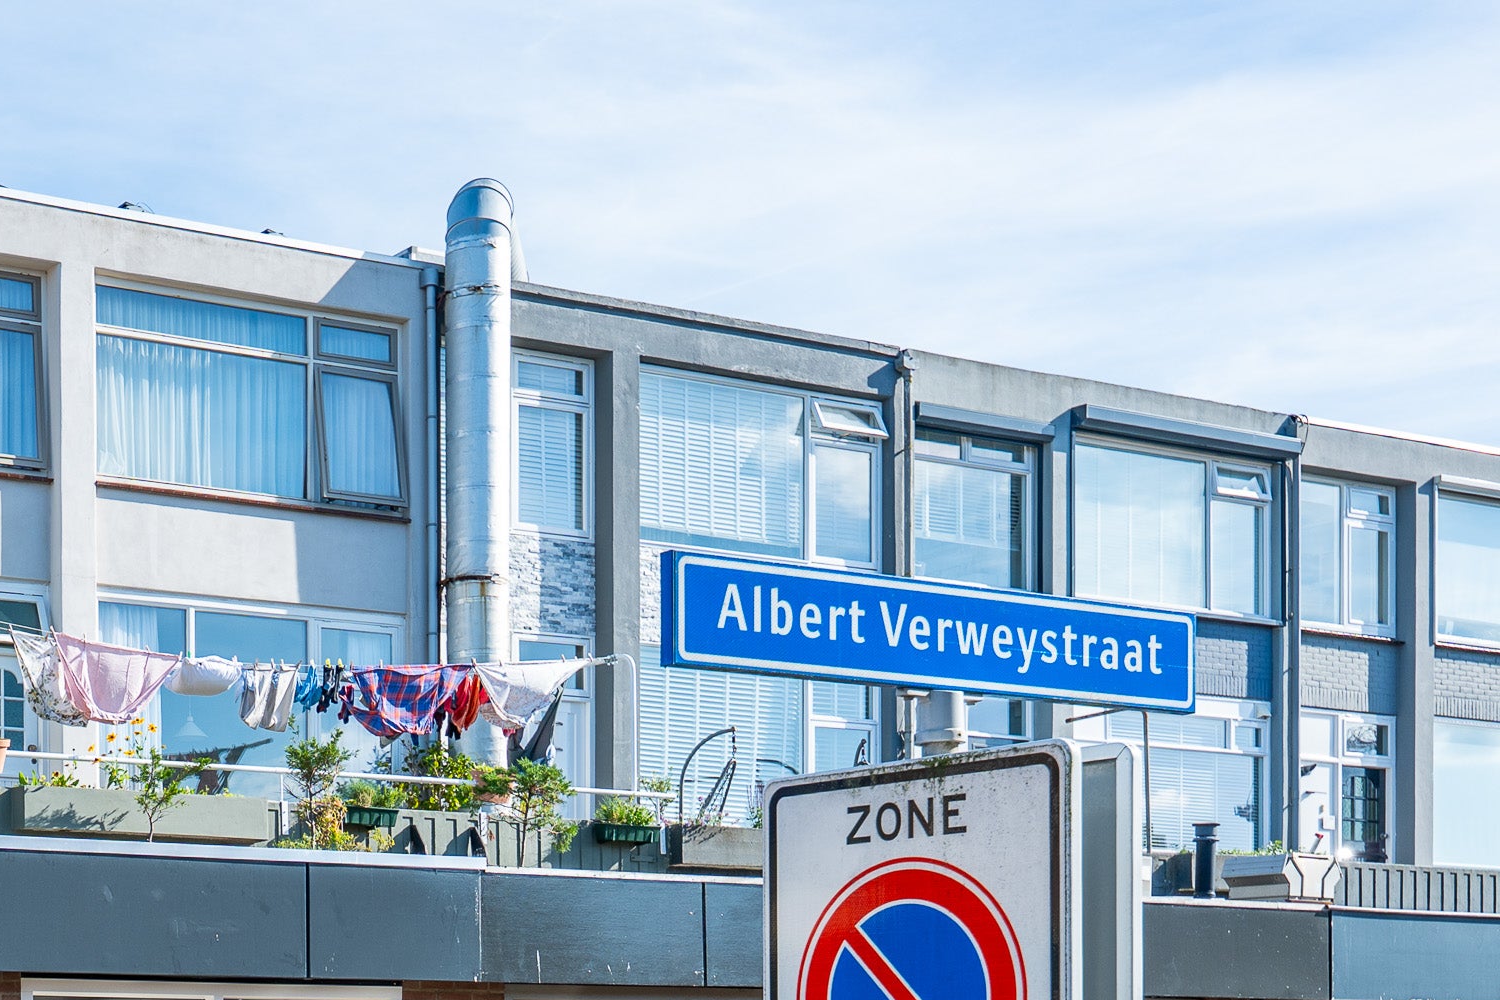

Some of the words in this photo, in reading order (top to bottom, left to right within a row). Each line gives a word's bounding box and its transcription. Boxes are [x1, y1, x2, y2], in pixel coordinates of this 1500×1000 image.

[717, 583, 866, 644] Albert
[879, 600, 1163, 675] Verweystraat
[846, 793, 967, 845] ZONE
